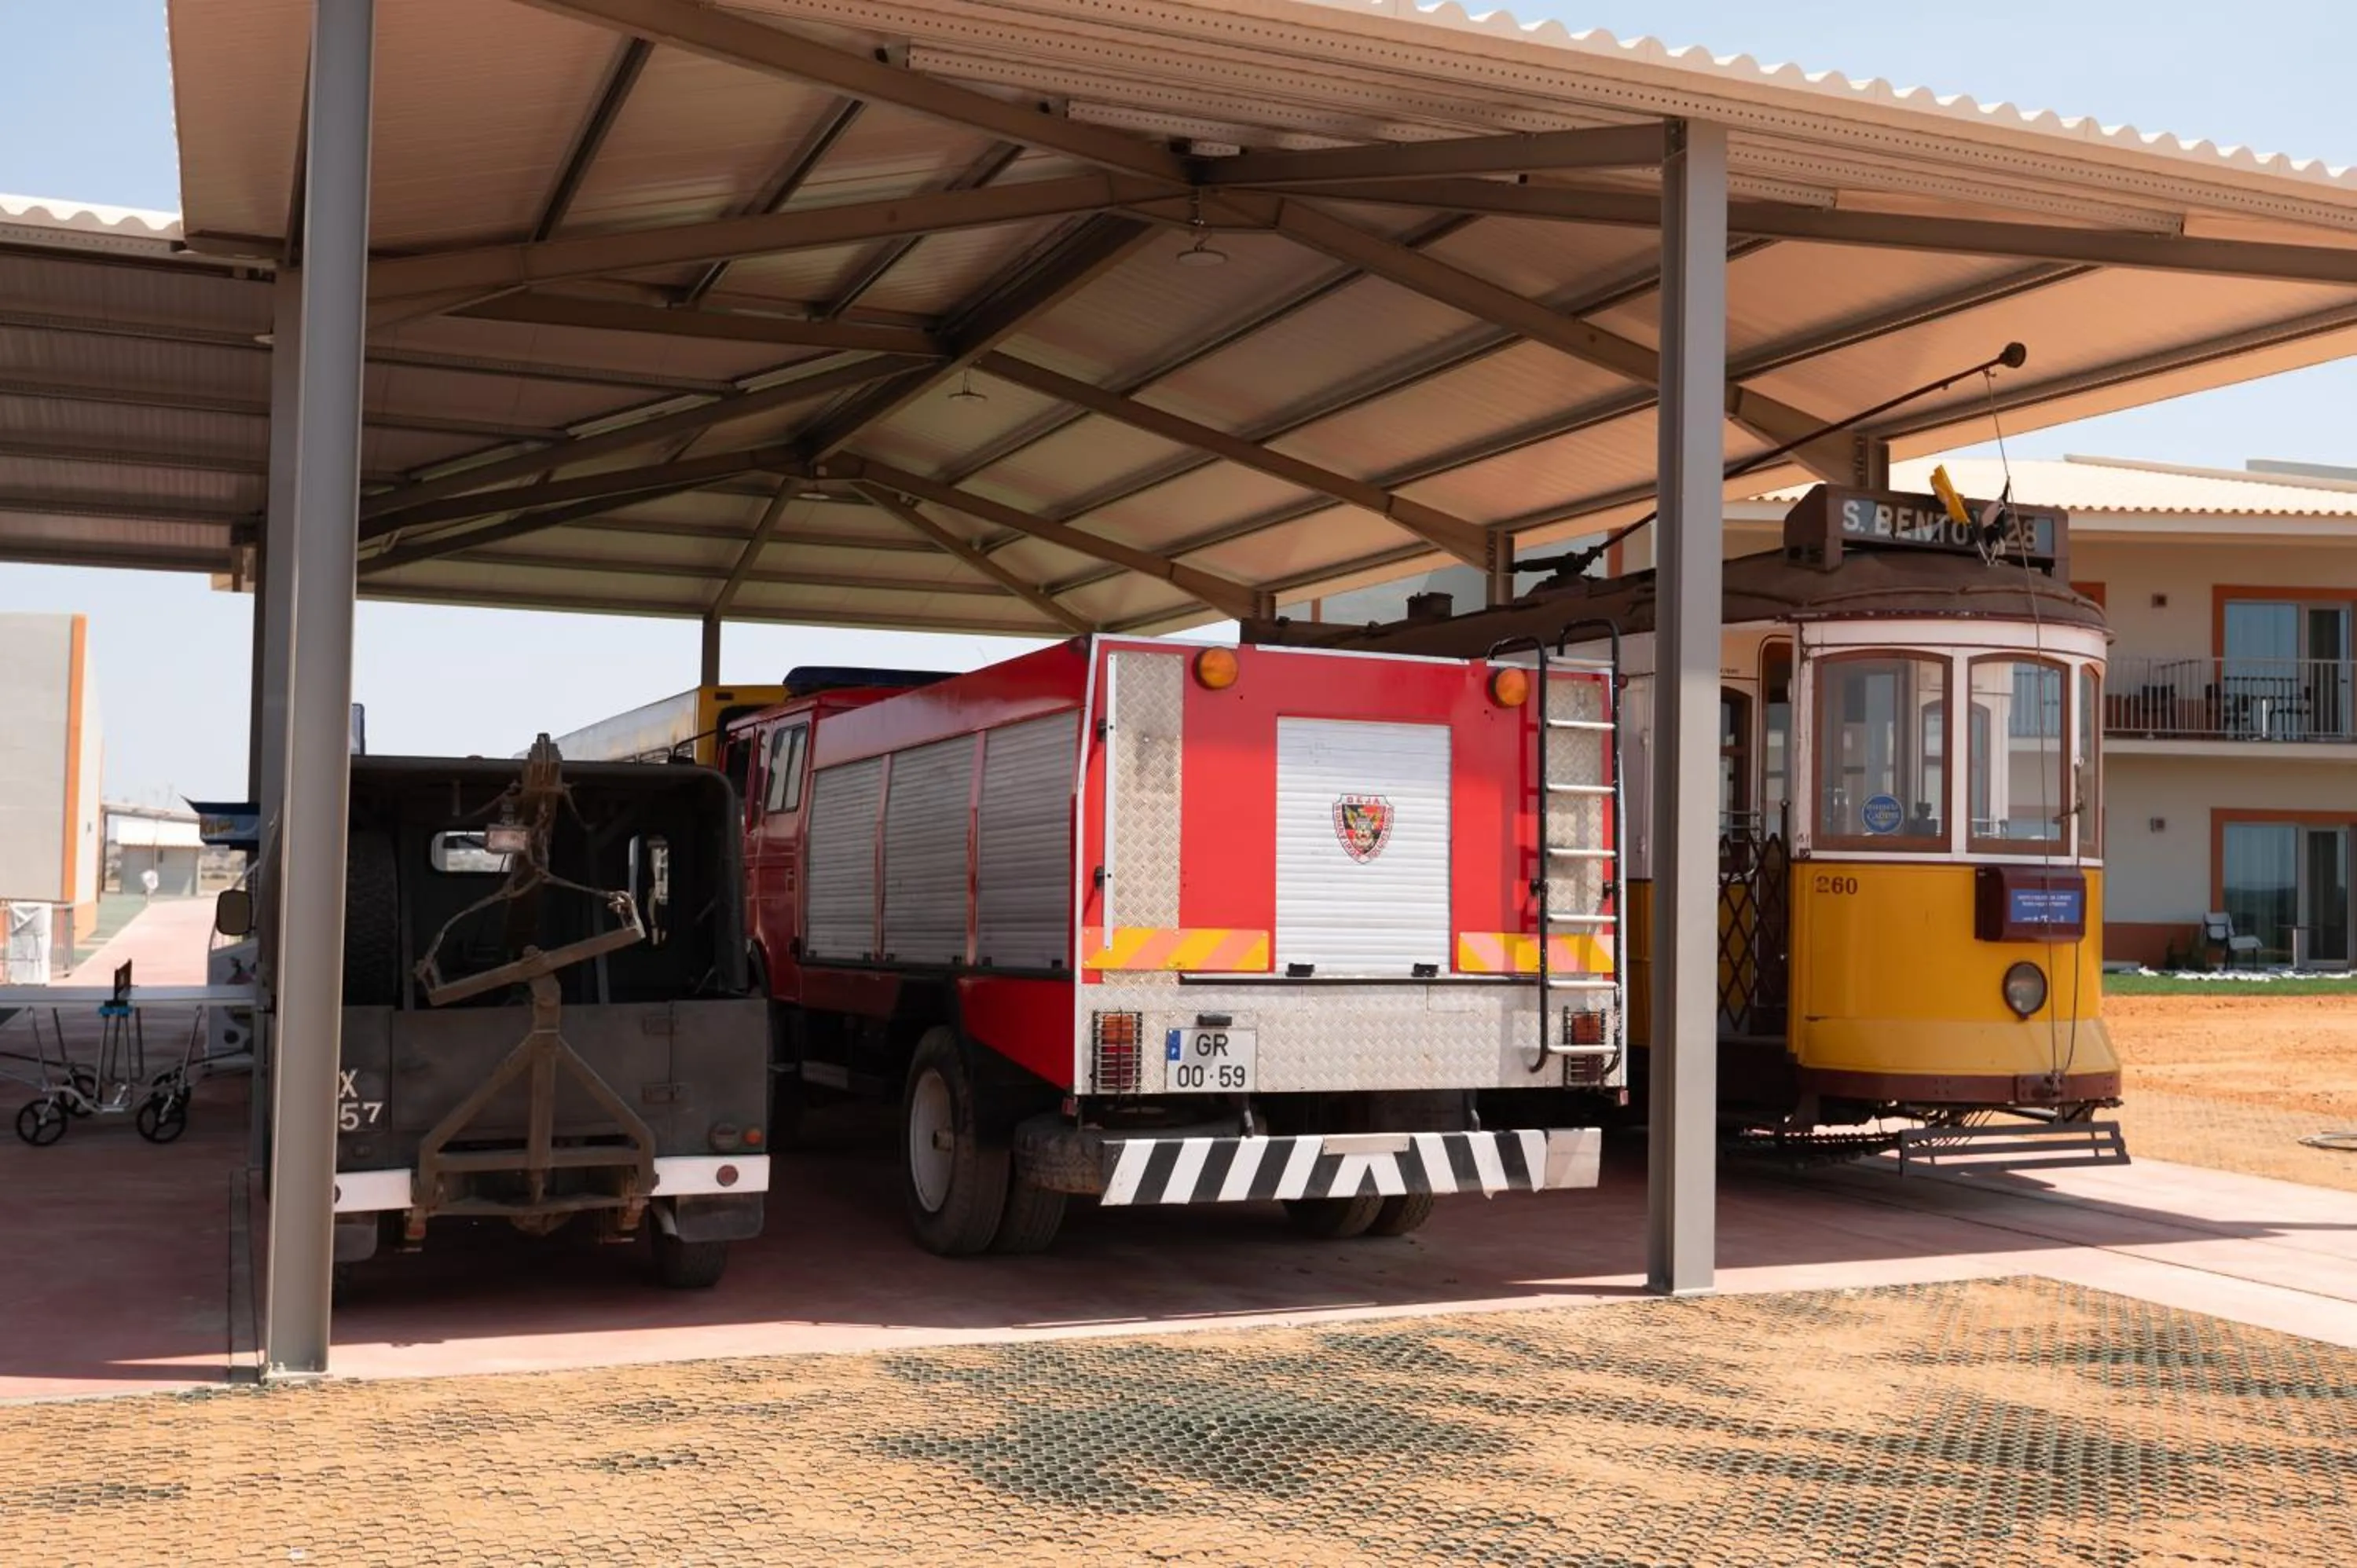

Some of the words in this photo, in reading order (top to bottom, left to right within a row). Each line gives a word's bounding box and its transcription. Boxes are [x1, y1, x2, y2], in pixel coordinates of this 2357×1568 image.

[1842, 500, 1865, 533] S.
[1874, 504, 1969, 545] BENTO
[2005, 518, 2037, 551] 28
[1815, 874, 1858, 896] 260
[1195, 1033, 1230, 1057] GR
[339, 1101, 383, 1132] 57
